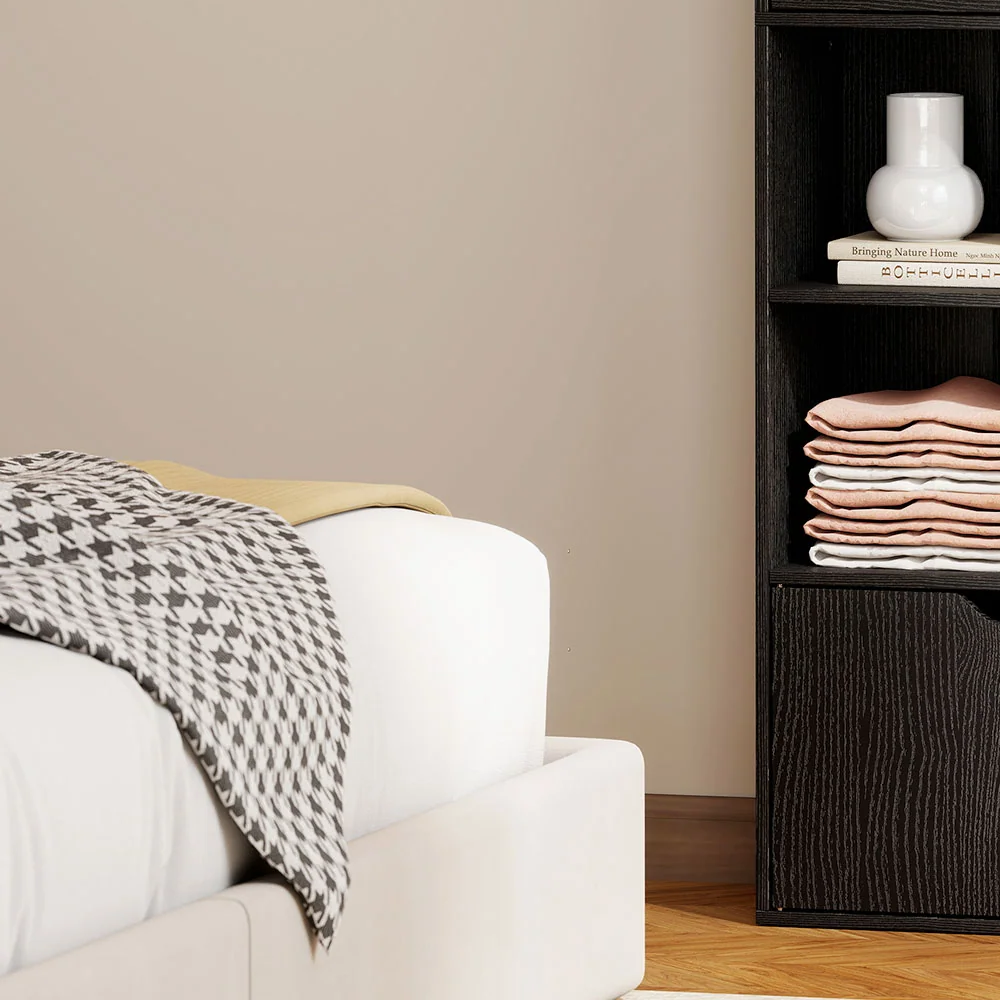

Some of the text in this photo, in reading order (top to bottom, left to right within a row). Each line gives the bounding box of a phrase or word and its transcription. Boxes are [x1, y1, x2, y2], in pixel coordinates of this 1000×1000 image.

[852, 246, 892, 259] Bringing
[894, 247, 928, 257] Nature
[929, 248, 958, 258] Home
